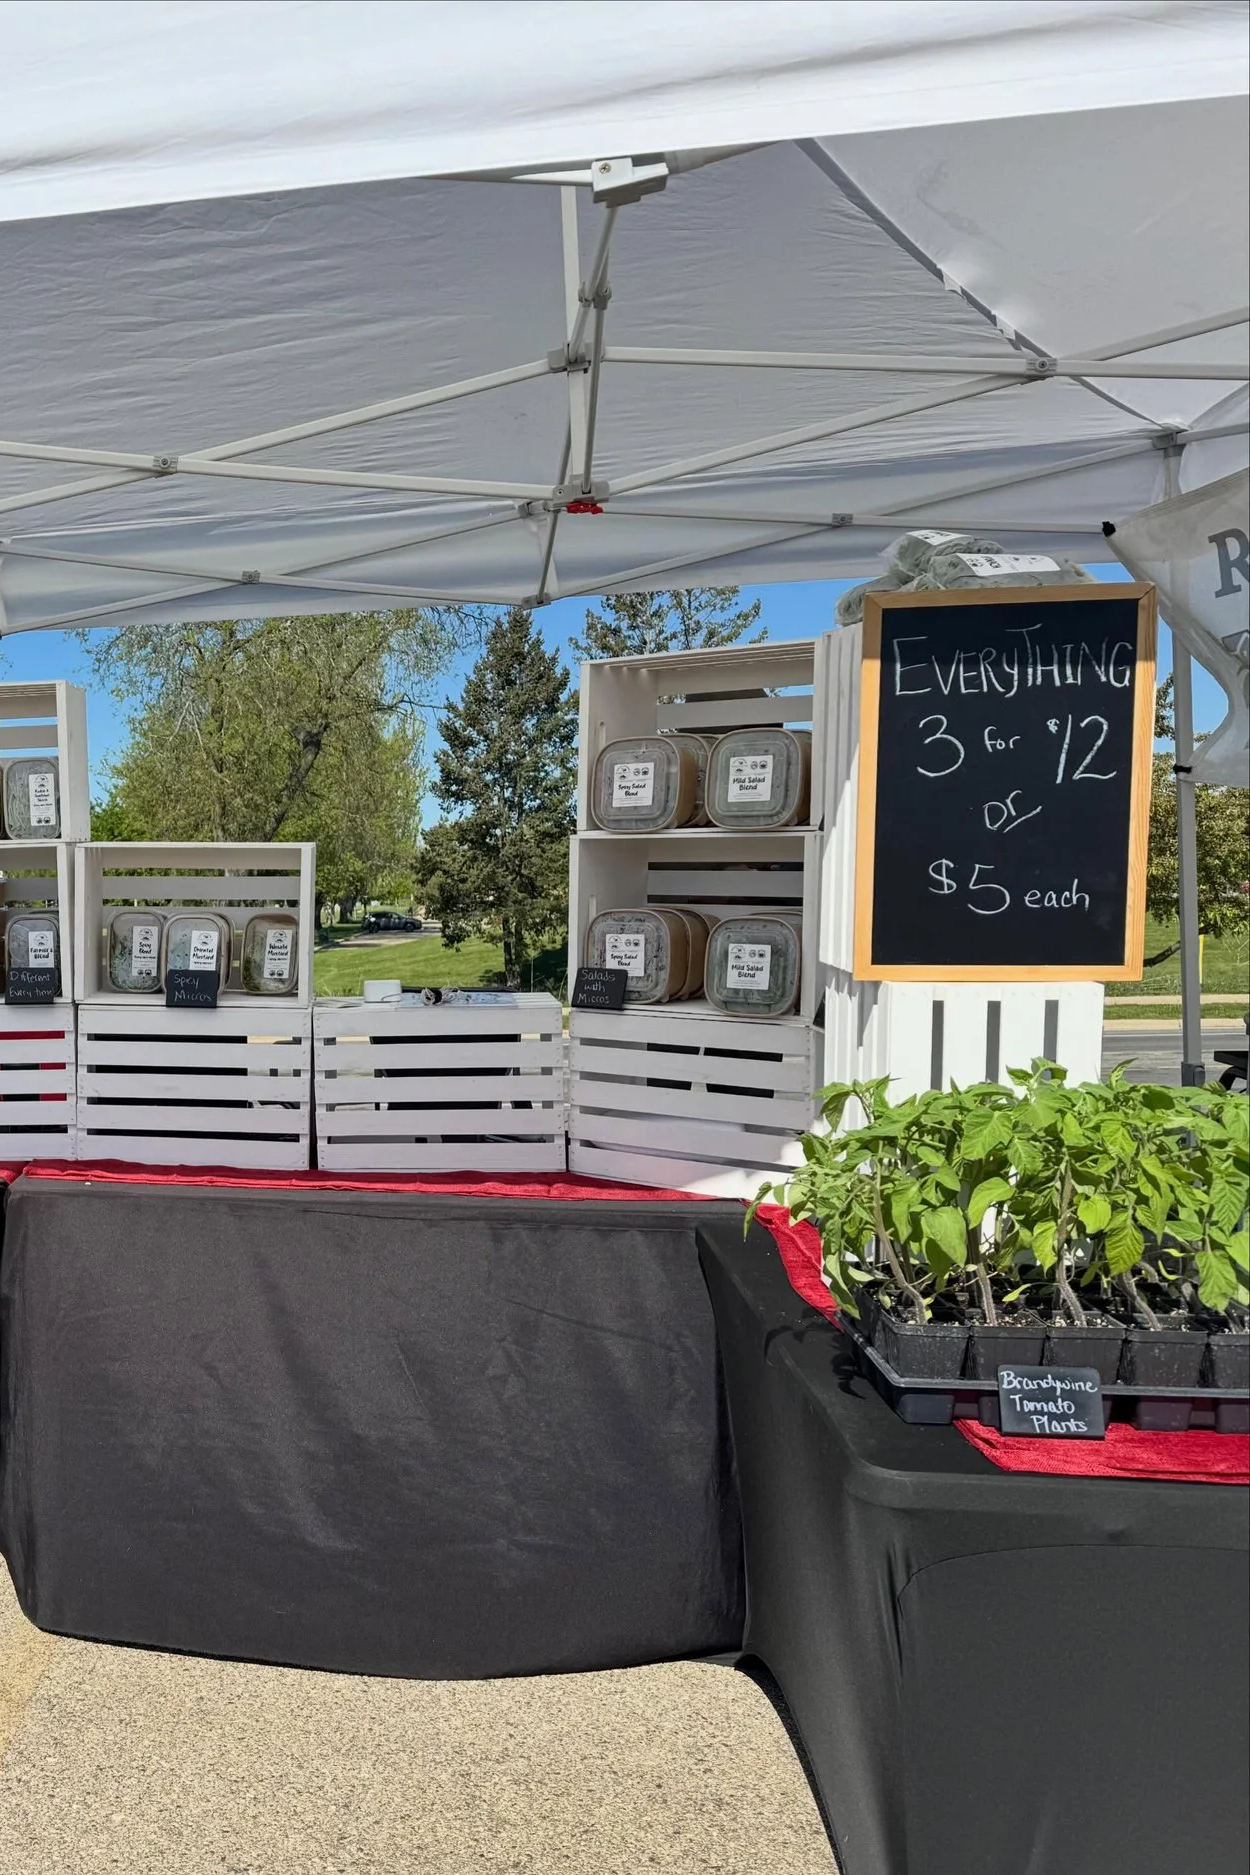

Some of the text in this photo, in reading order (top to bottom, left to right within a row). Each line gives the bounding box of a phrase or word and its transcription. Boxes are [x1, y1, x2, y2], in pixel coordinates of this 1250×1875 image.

[893, 624, 1133, 697] EVERYTHING
[917, 714, 1117, 784] 3 for $12
[983, 790, 1032, 832] or
[1024, 879, 1089, 910] each
[174, 973, 199, 988] Spicy
[581, 969, 616, 981] Salads
[584, 982, 605, 992] with
[577, 993, 610, 1004] Micros
[1000, 1370, 1098, 1395] Brandywine
[1010, 1394, 1075, 1414] Tomato
[1030, 1415, 1088, 1433] Plants
